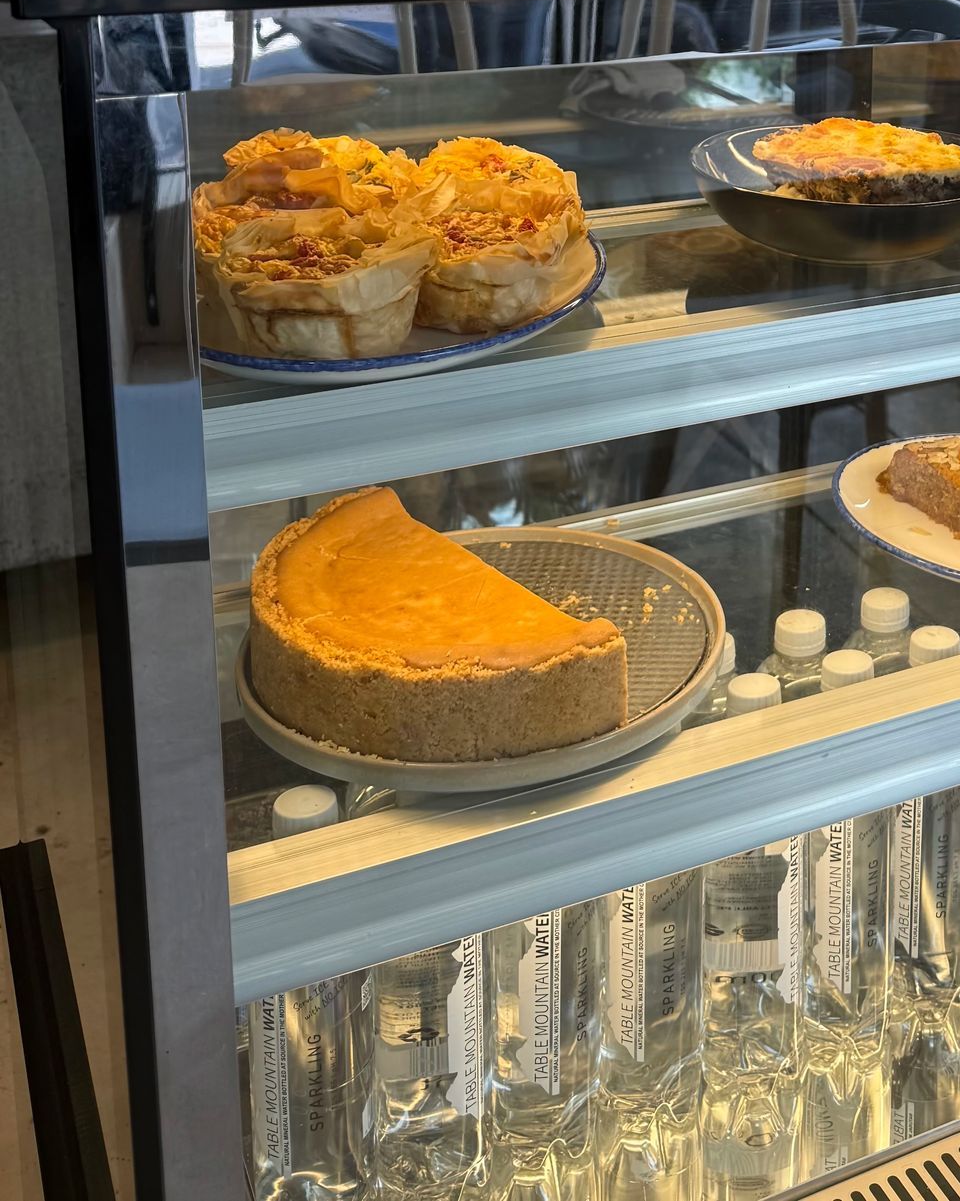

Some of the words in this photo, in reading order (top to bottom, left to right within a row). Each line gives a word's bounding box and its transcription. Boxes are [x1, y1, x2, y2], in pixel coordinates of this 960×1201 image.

[830, 822, 842, 862] WATE
[900, 831, 912, 900] MOUNTAIN
[936, 833, 949, 918] SPARKLING
[790, 880, 799, 956] MOUNTAIN
[829, 866, 841, 936] MOUNTAIN
[868, 859, 879, 947] SPARKLING
[898, 904, 909, 940] TABLE
[463, 936, 475, 984] WATE
[535, 914, 549, 958] WATE
[828, 939, 840, 978] TABLE
[621, 927, 634, 1000] MOUNTAIN
[663, 924, 675, 1016] SPARKLING
[790, 960, 798, 1000] TABLE
[262, 996, 275, 1031] WAT
[293, 994, 313, 1013] Serve
[313, 980, 329, 997] ICE
[305, 1004, 321, 1020] with
[535, 962, 549, 1036] MOUNTAIN
[577, 947, 587, 1041] SPARKLING
[464, 985, 476, 1063] MOUNTAIN
[621, 1003, 633, 1044] TABLE
[264, 1035, 278, 1114] MOUNTAIN
[281, 1062, 287, 1070] AT
[308, 1034, 324, 1132] SPARKLING
[535, 1040, 548, 1082] TABLE
[465, 1063, 476, 1113] TABLE
[266, 1115, 280, 1159] TABLE
